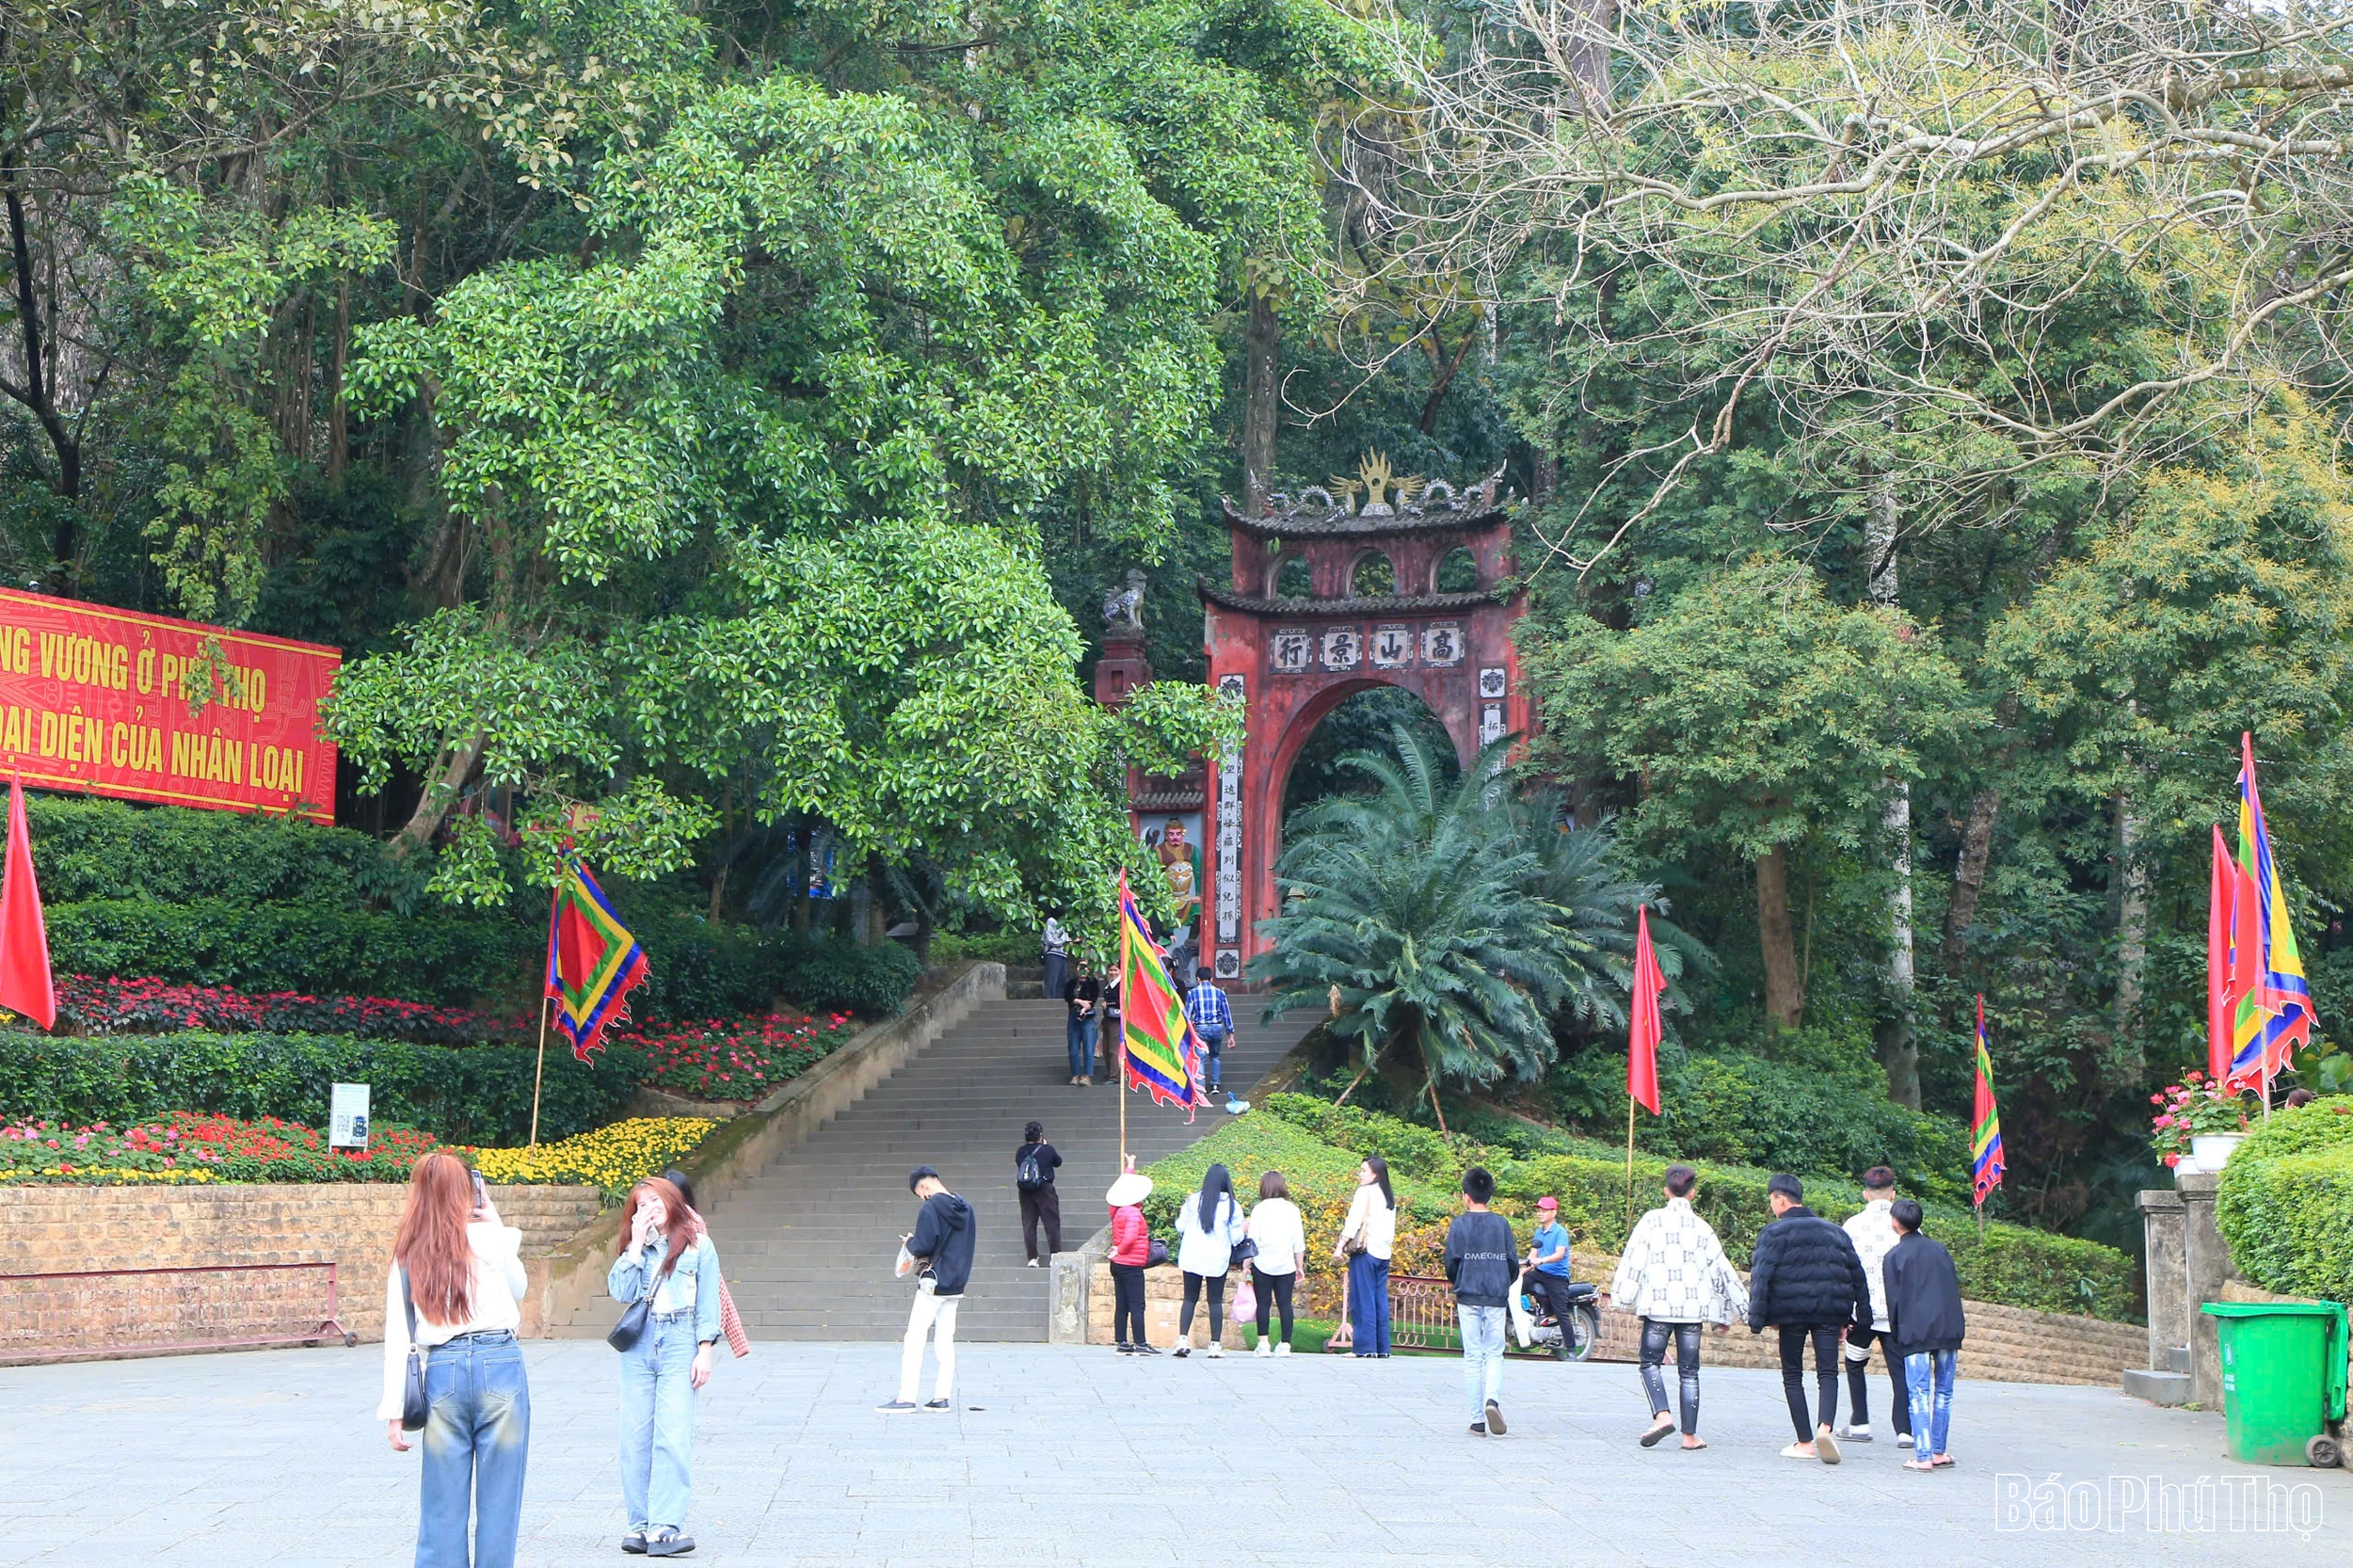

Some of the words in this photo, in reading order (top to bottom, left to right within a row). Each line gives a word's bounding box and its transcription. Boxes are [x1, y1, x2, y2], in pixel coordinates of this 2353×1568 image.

[40, 631, 129, 690] VƯƠNG
[136, 630, 156, 695] Ở
[161, 651, 212, 704] PH
[0, 705, 32, 763] ẠI
[40, 705, 103, 772] DIỆN
[111, 705, 163, 773] CỦA
[170, 728, 244, 785] NHÂN
[248, 743, 304, 802] LOẠI
[1464, 1252, 1507, 1261] OMEONE
